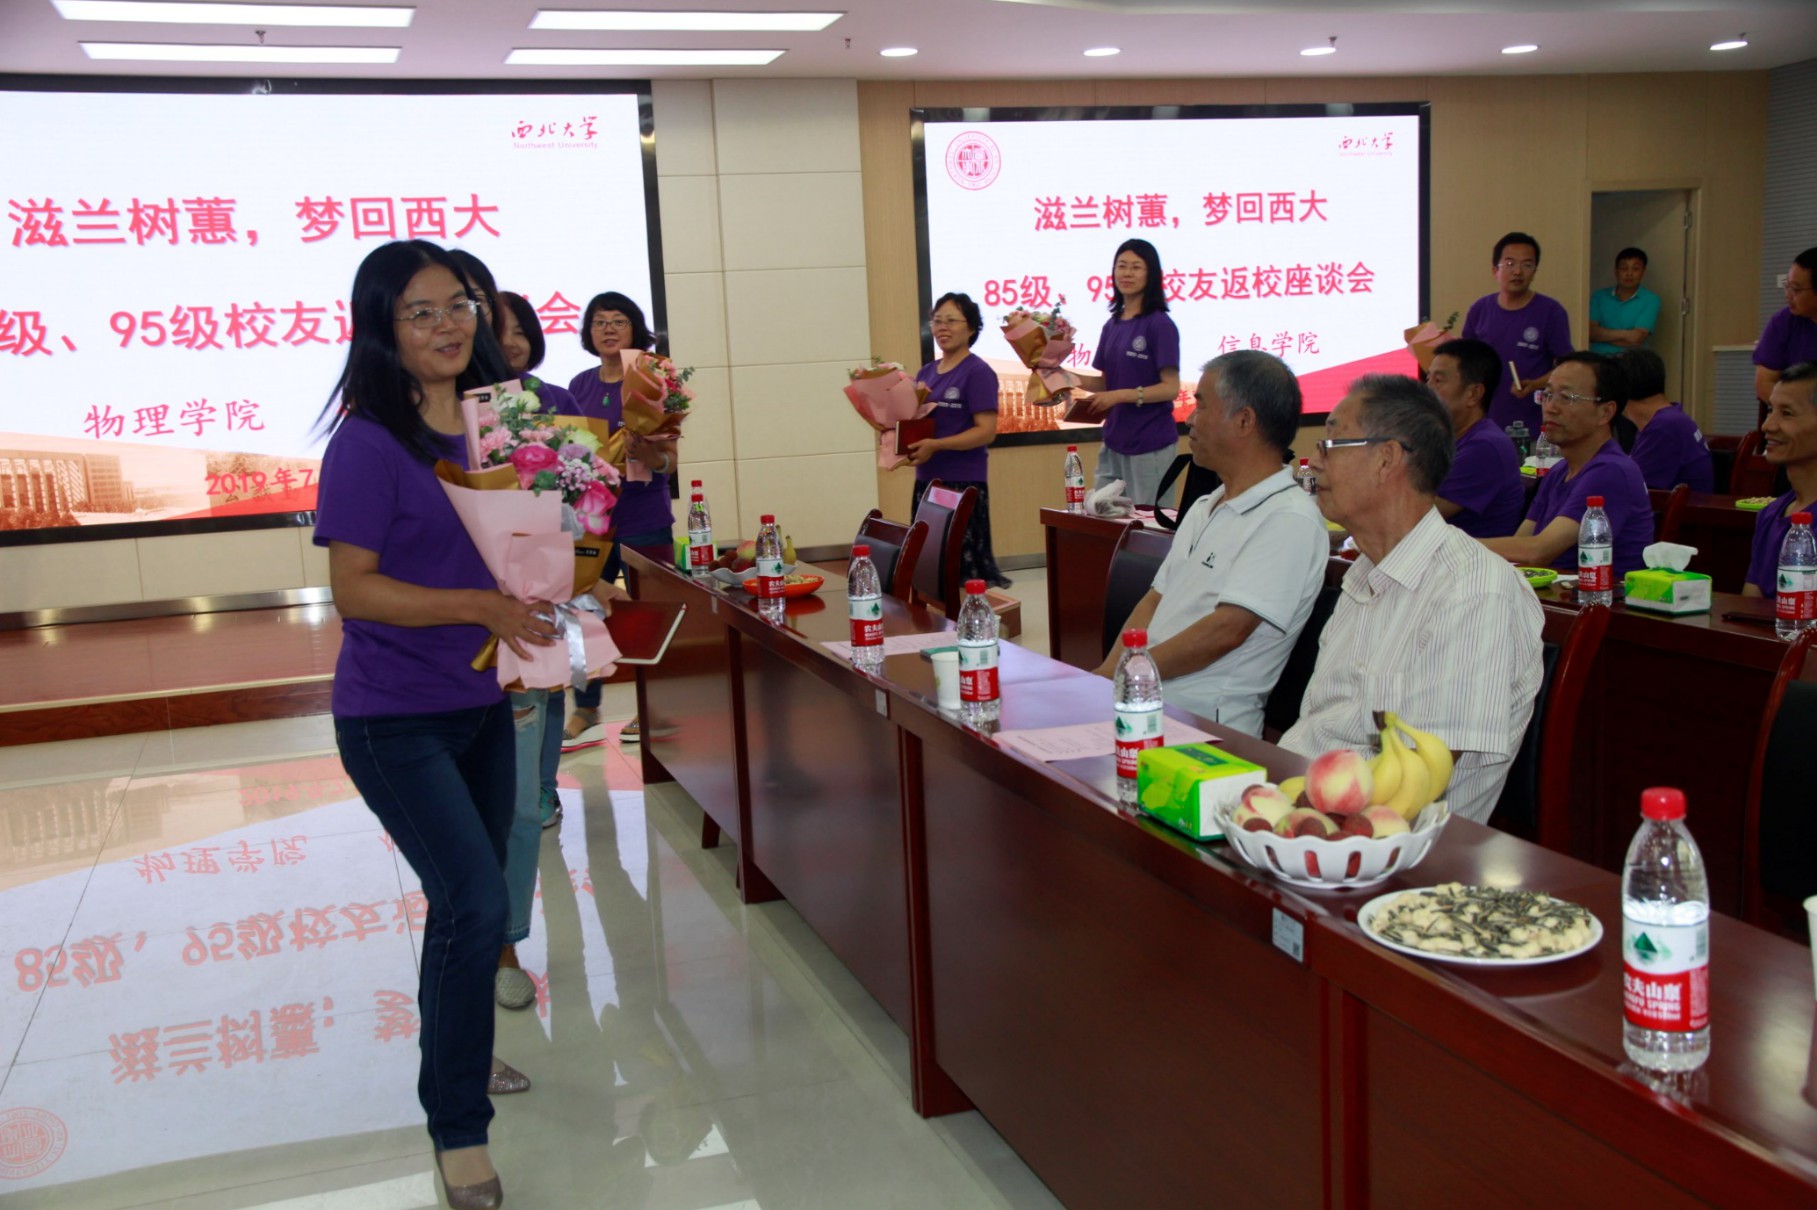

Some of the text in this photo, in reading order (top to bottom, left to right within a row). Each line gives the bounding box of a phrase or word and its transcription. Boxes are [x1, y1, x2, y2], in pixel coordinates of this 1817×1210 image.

[511, 115, 598, 141] 西北大学
[558, 141, 598, 149] University
[84, 397, 265, 440] 物理学院
